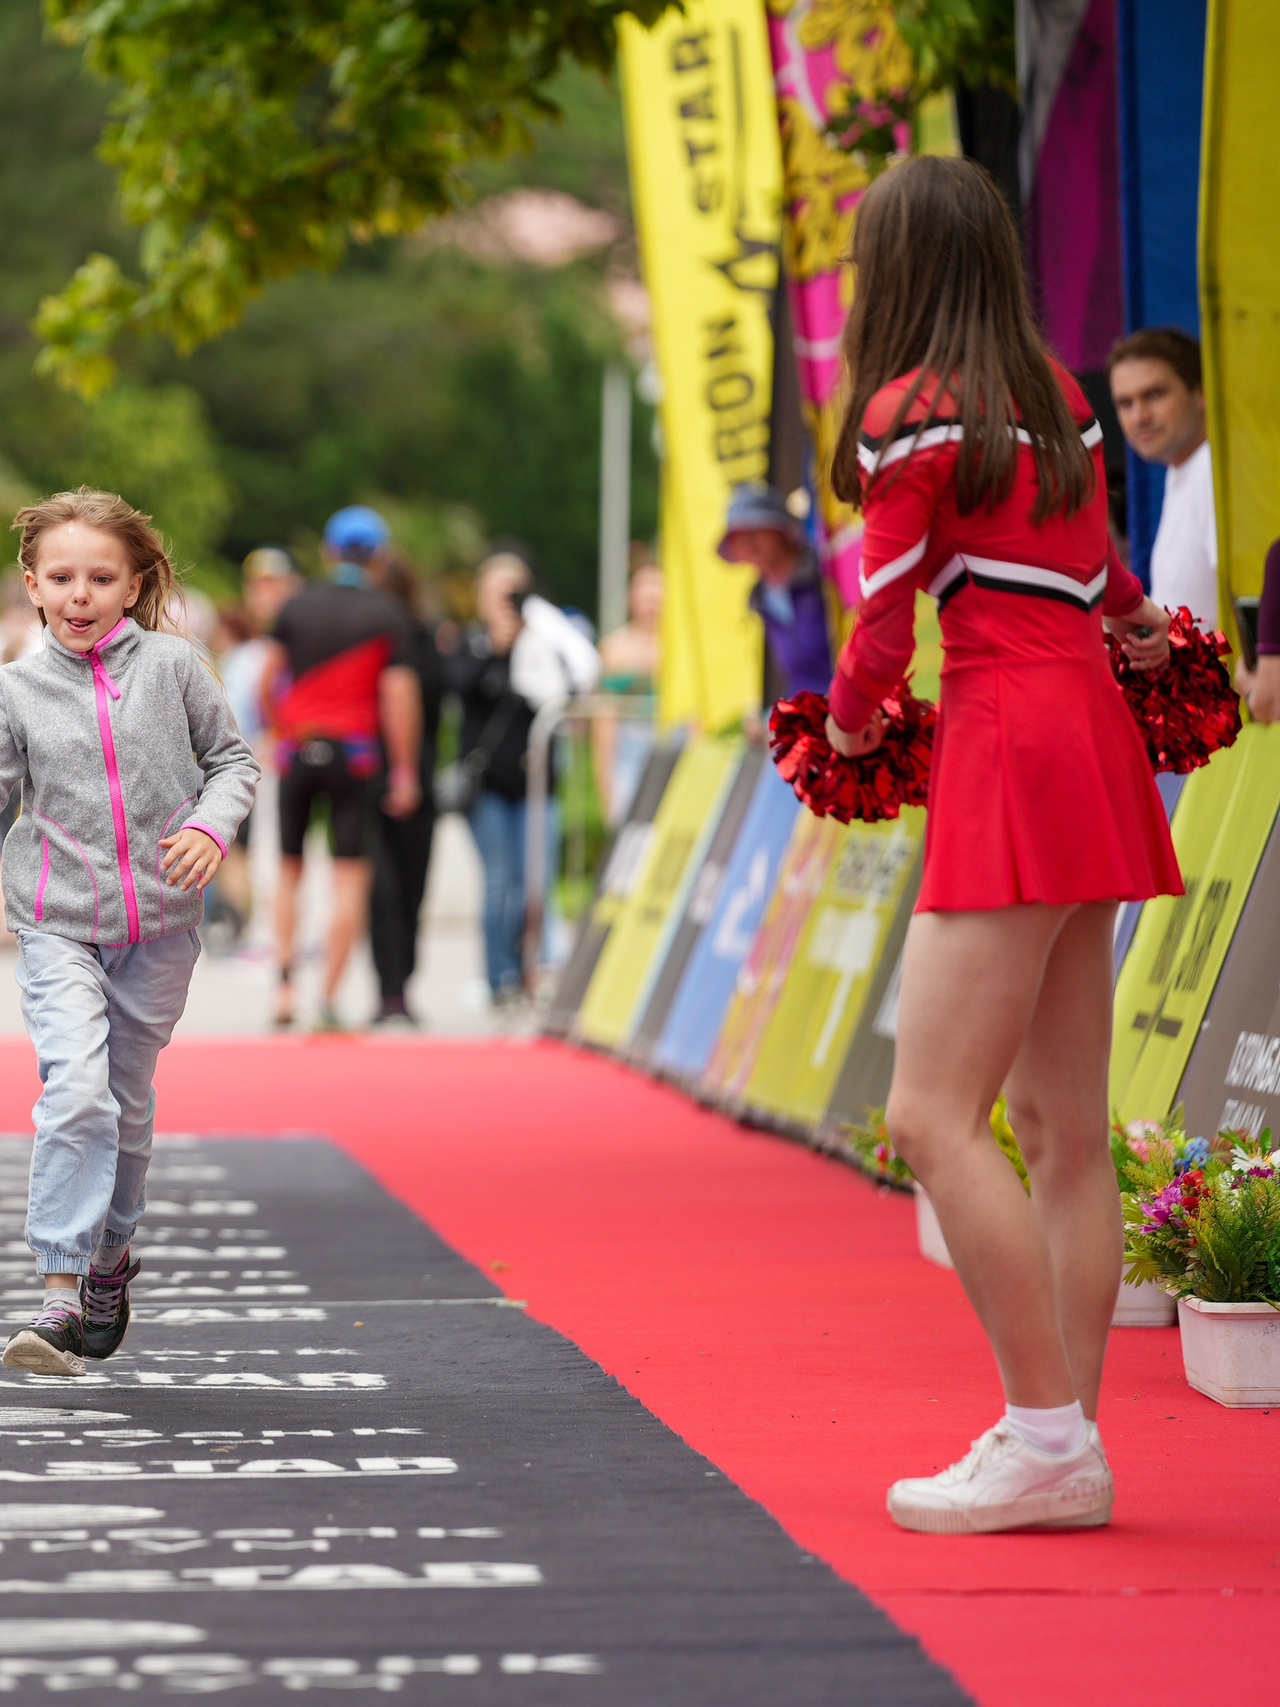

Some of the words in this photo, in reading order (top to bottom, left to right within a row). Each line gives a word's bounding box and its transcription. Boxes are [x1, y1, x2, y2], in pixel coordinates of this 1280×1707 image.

[668, 26, 725, 216] STAR
[26, 1372, 389, 1387] STAR
[45, 1457, 459, 1476] STAR
[66, 1562, 543, 1587] STAR
